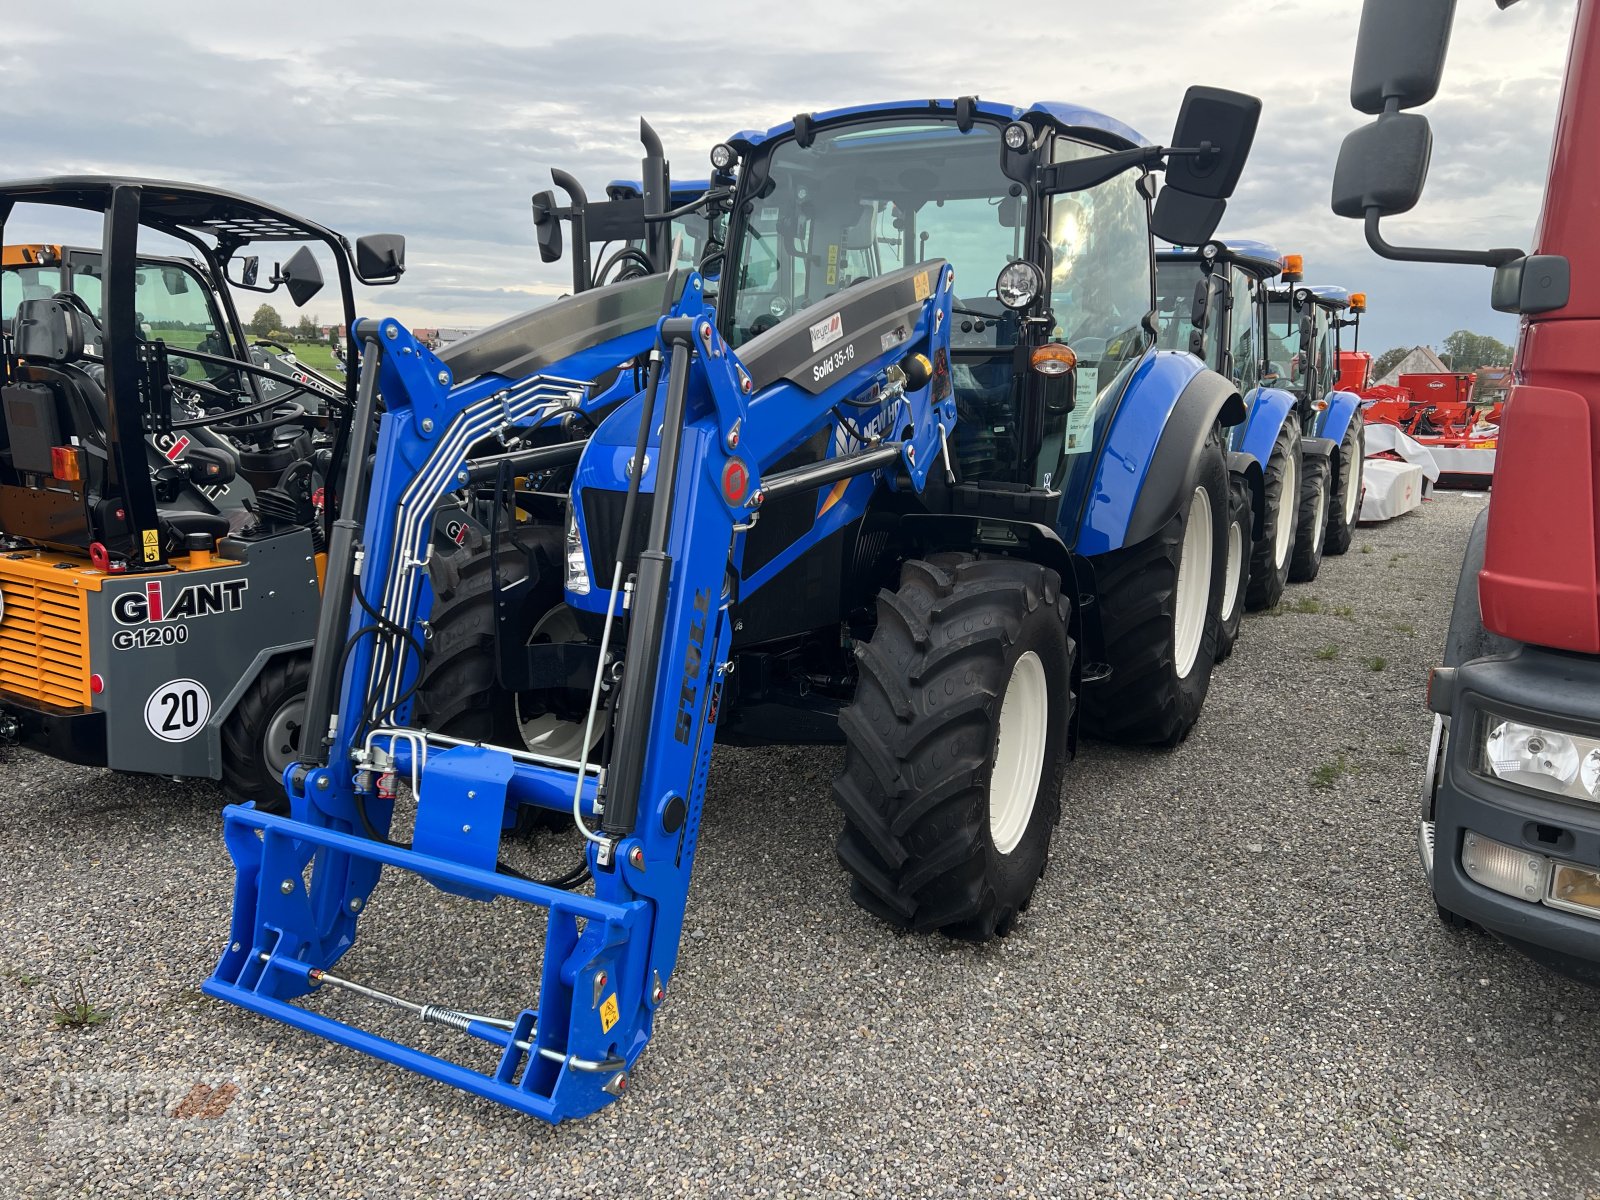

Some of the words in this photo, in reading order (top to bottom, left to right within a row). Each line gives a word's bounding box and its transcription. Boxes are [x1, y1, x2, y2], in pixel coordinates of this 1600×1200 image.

[813, 356, 834, 382] Solid
[834, 344, 855, 368] 35-18
[863, 411, 887, 446] NEW
[112, 624, 189, 650] G1200
[674, 587, 711, 746] STOLL
[161, 689, 199, 732] 20
